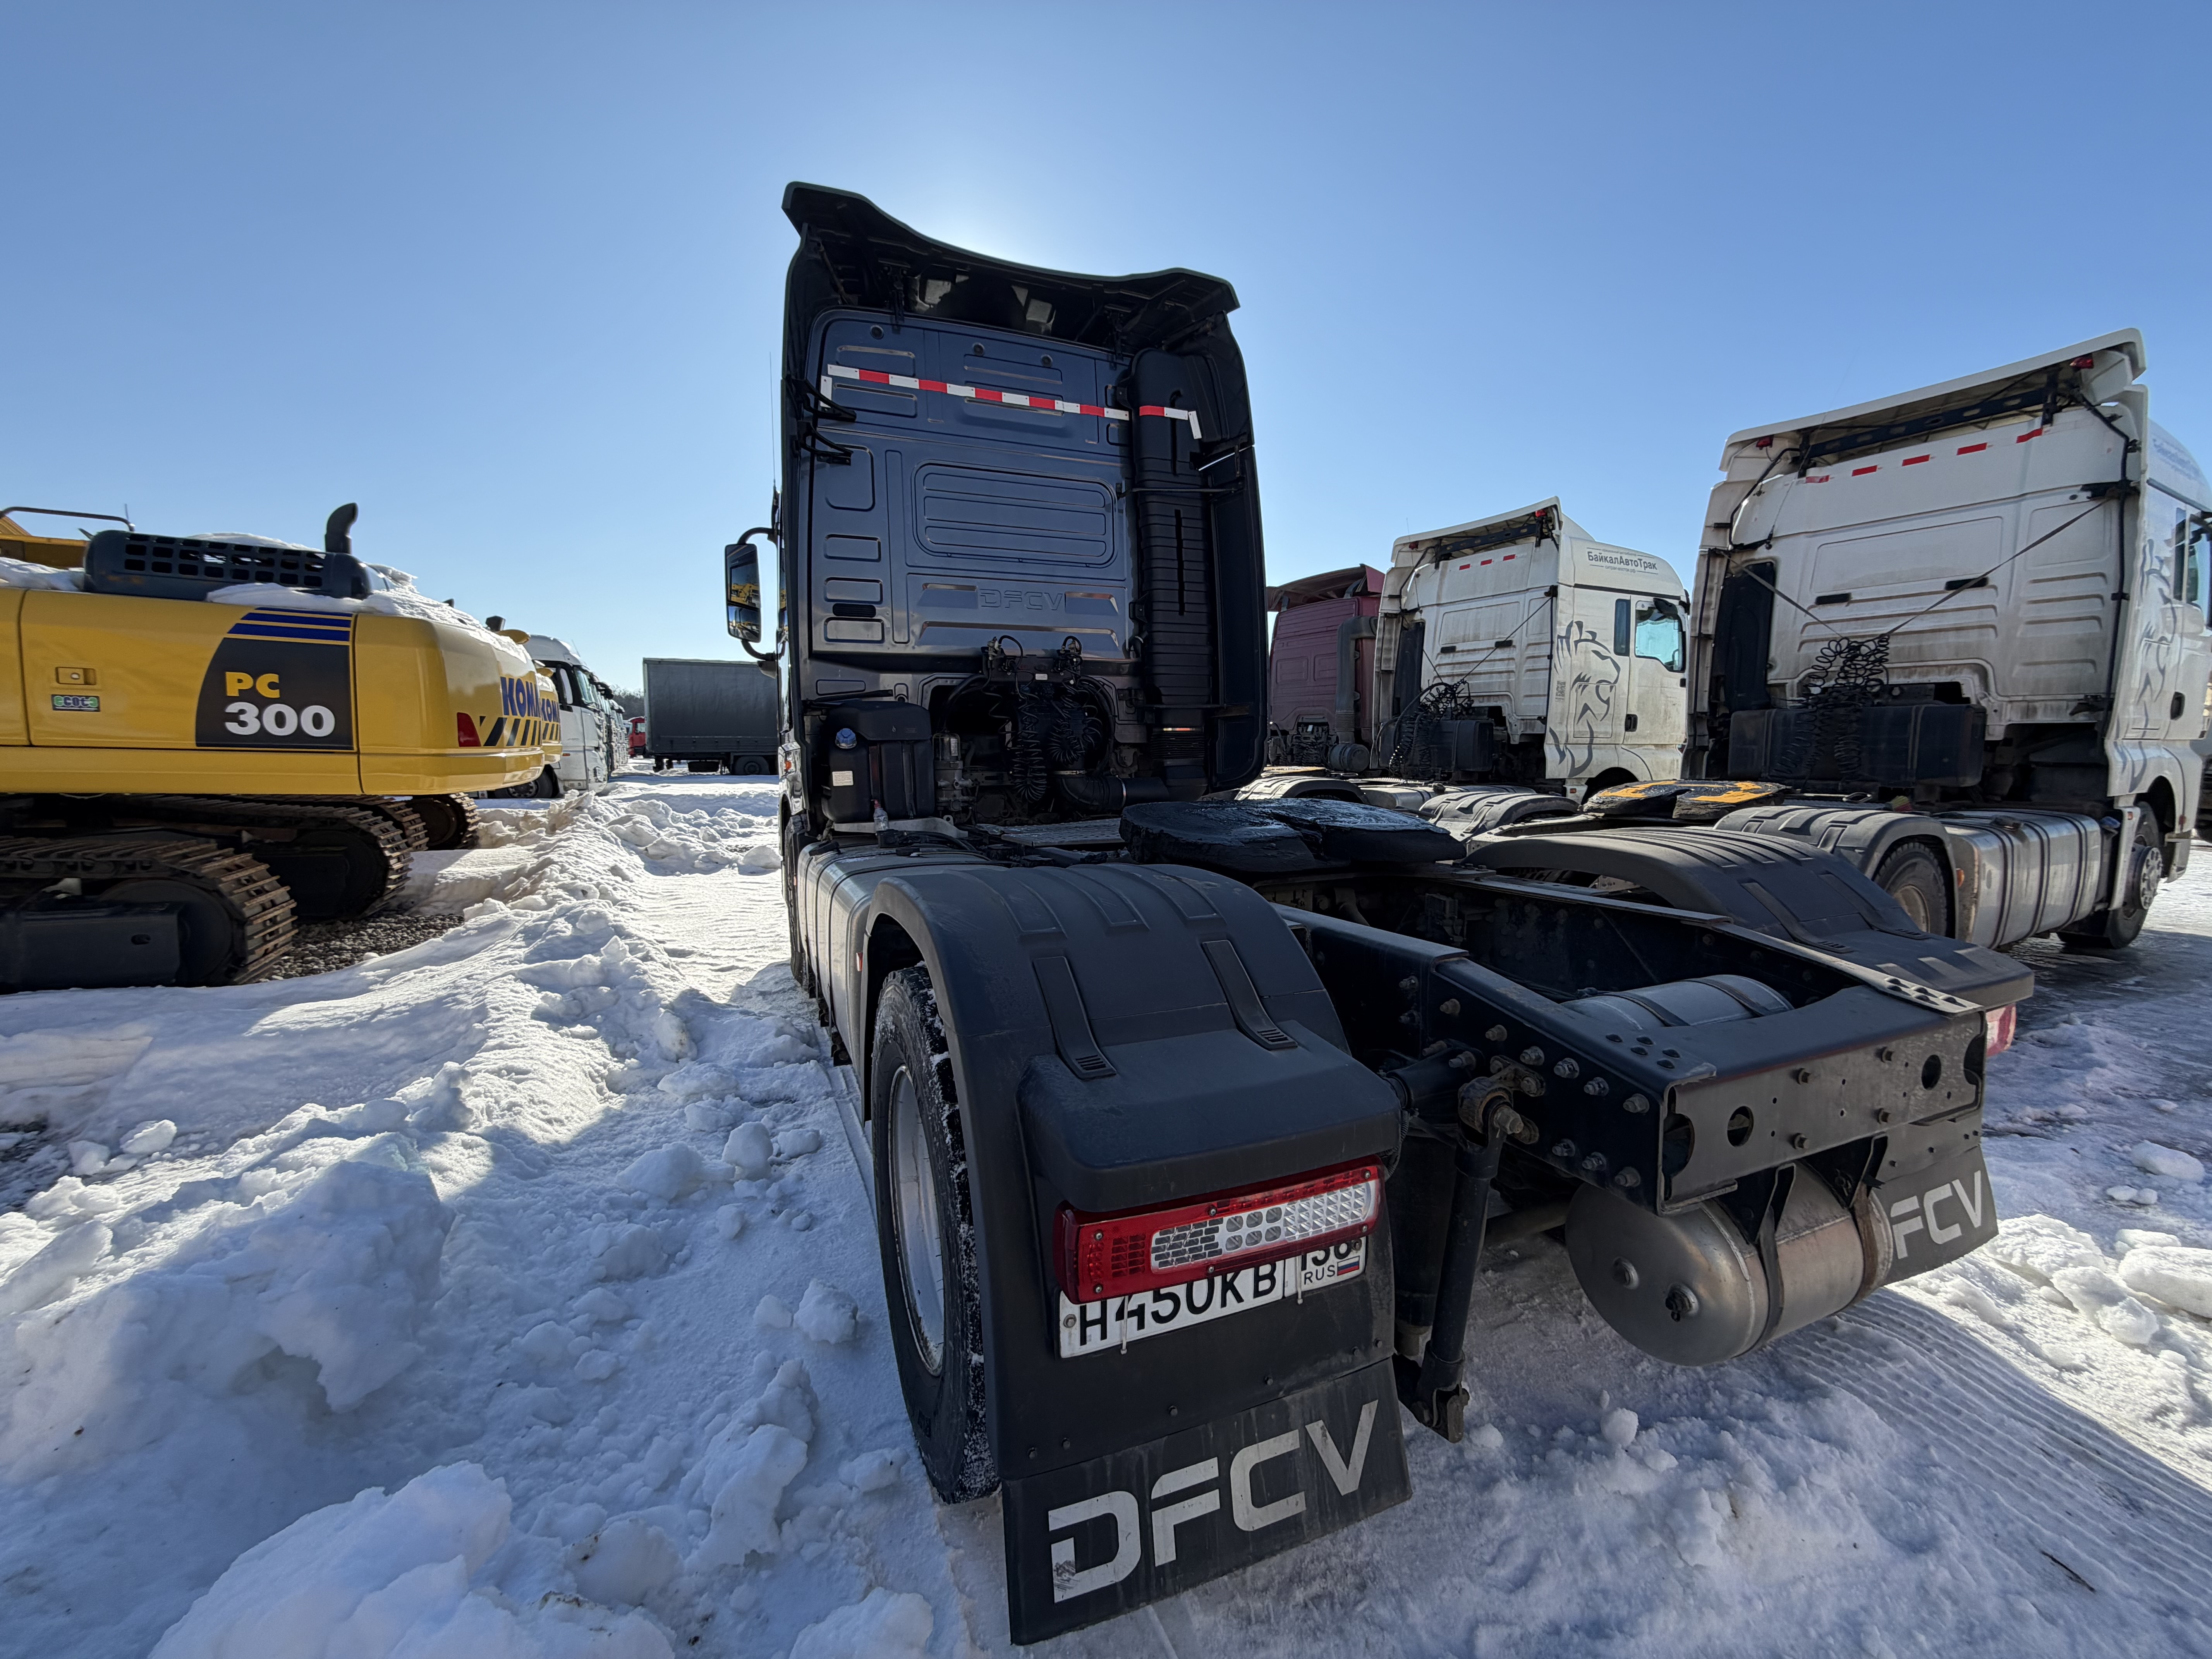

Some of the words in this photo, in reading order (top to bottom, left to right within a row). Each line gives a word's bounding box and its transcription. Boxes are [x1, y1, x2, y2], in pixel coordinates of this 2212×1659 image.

[1587, 551, 1657, 570] БайкалАвтоТрак
[980, 588, 1063, 611] DFCV
[225, 672, 280, 698] PC
[224, 702, 335, 737] 300
[1304, 1264, 1335, 1285] RUS
[1048, 1399, 1379, 1603] DFCV
